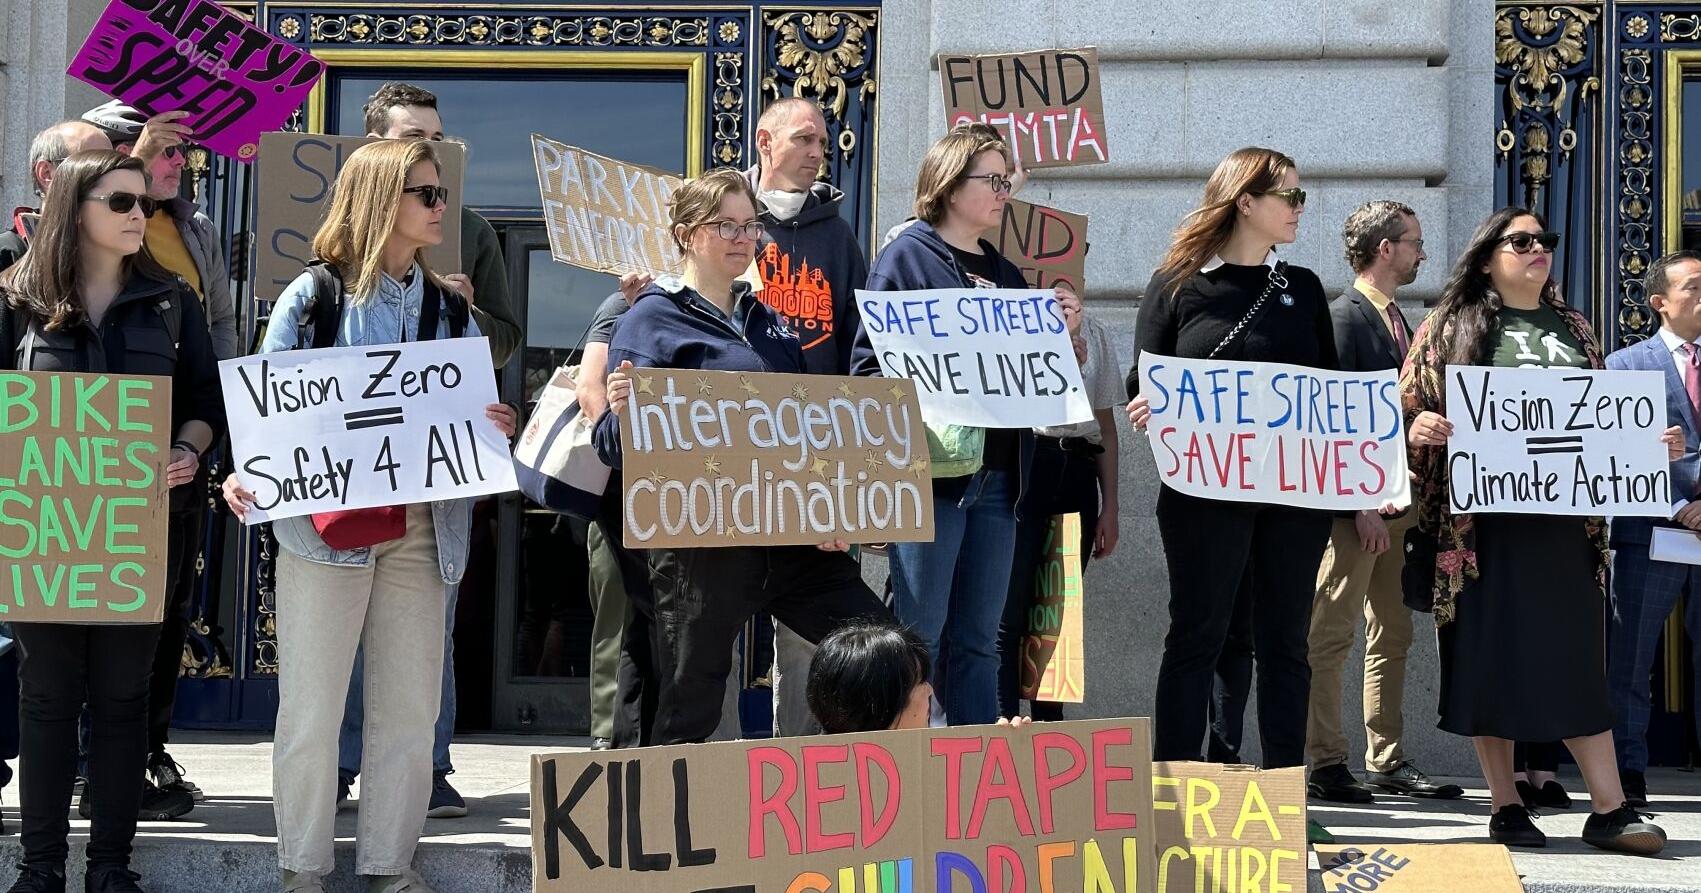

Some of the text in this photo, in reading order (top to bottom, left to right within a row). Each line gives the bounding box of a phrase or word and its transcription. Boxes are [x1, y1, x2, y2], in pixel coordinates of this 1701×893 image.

[118, 0, 321, 93] AFETY!
[175, 38, 230, 80] OVER
[83, 32, 257, 140] SPEED
[945, 53, 1090, 110] FUND
[863, 297, 1065, 337] SAFE STREETS
[0, 374, 153, 433] BIKE
[237, 350, 462, 417] Vision Zero
[882, 351, 1078, 397] SAVE LIVES.
[1148, 364, 1400, 442] SAFE STREETS
[1456, 371, 1654, 432] Vision Zero
[628, 376, 912, 473] Interagency
[244, 446, 353, 511] Safety
[373, 435, 401, 492] 4
[425, 420, 486, 488] All
[1160, 427, 1386, 496] SAVE LIVES
[1449, 451, 1670, 511] Climate Action
[0, 490, 148, 558] SAVE
[625, 458, 923, 542] coordination
[0, 561, 147, 613] IVES
[542, 728, 1136, 880] KILL RED TAPE
[1322, 848, 1366, 877] NO
